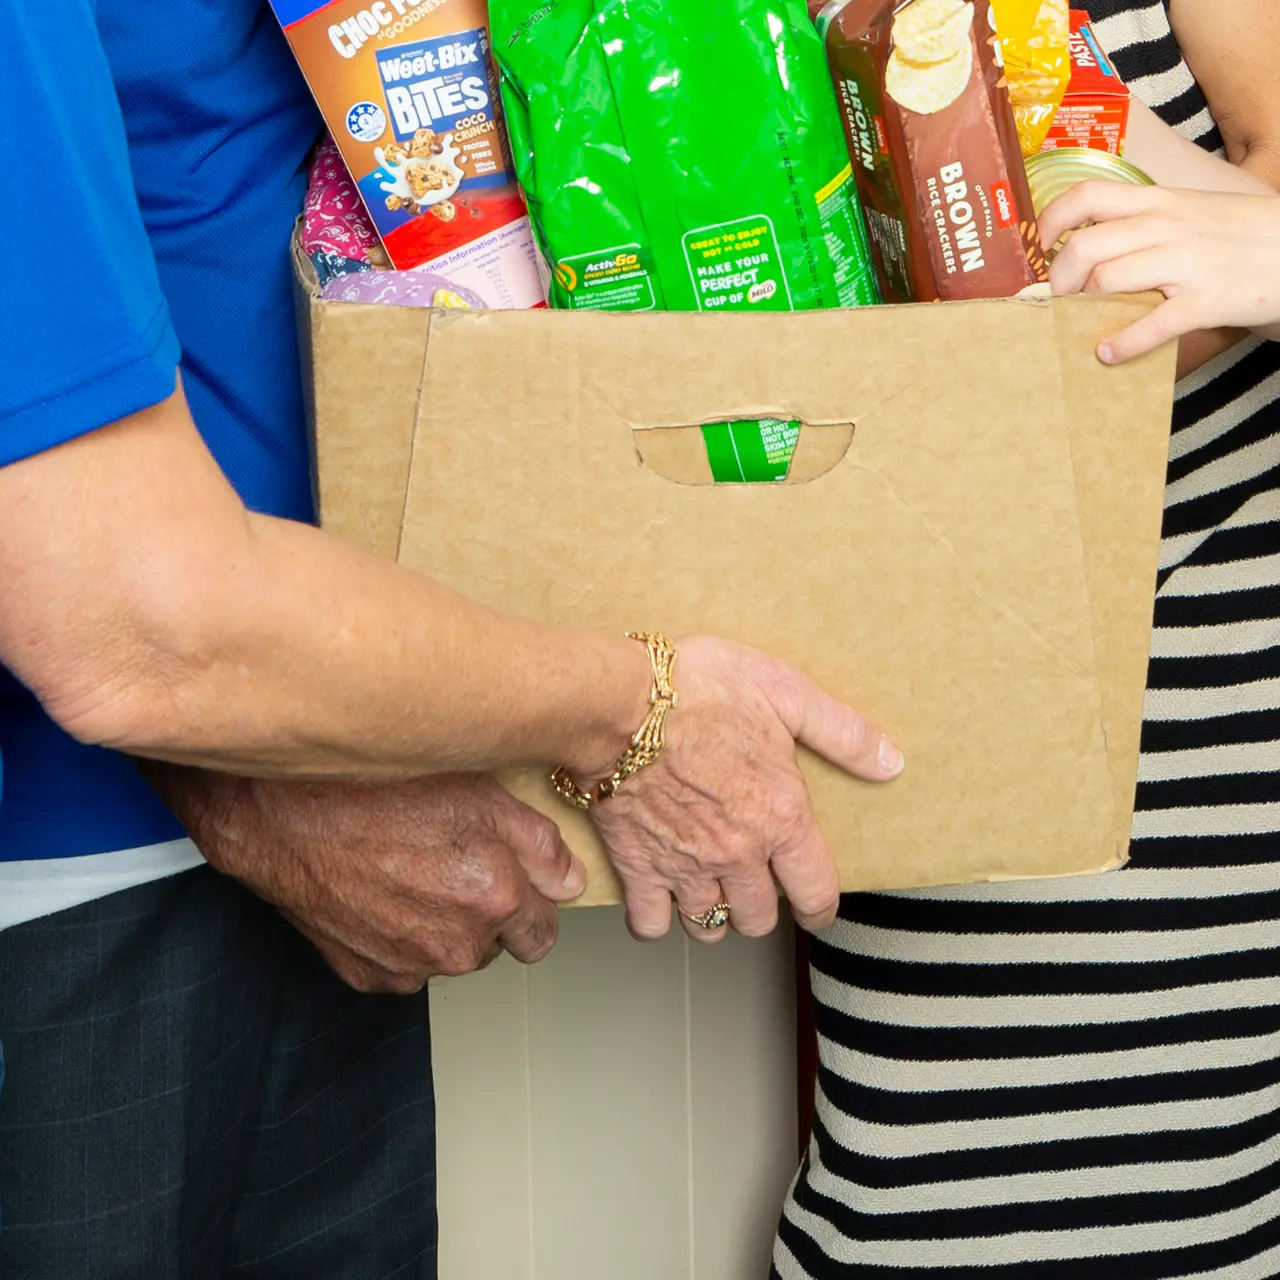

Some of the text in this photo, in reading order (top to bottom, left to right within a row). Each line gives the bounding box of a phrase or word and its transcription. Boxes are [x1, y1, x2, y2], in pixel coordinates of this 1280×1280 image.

[328, 1, 393, 59] CHOC
[379, 42, 478, 83] Weet-Bix
[454, 120, 494, 142] CRUNCH
[455, 112, 486, 130] COCO
[846, 79, 875, 171] BROWN
[940, 161, 985, 272] BROWN
[975, 185, 992, 237] OVEN BAKED
[996, 189, 1010, 220] coles
[690, 226, 767, 250] GREAT TO ENJOY
[927, 177, 957, 273] RICE CRACKERS
[422, 260, 449, 274] trition
[449, 237, 498, 263] Information
[703, 247, 721, 258] HOT
[735, 239, 760, 250] COLD
[697, 253, 769, 277] MAKE YOUR
[700, 268, 759, 293] PERFECT
[704, 295, 727, 307] CUP
[729, 292, 744, 303] OF
[764, 441, 785, 452] SKIM
